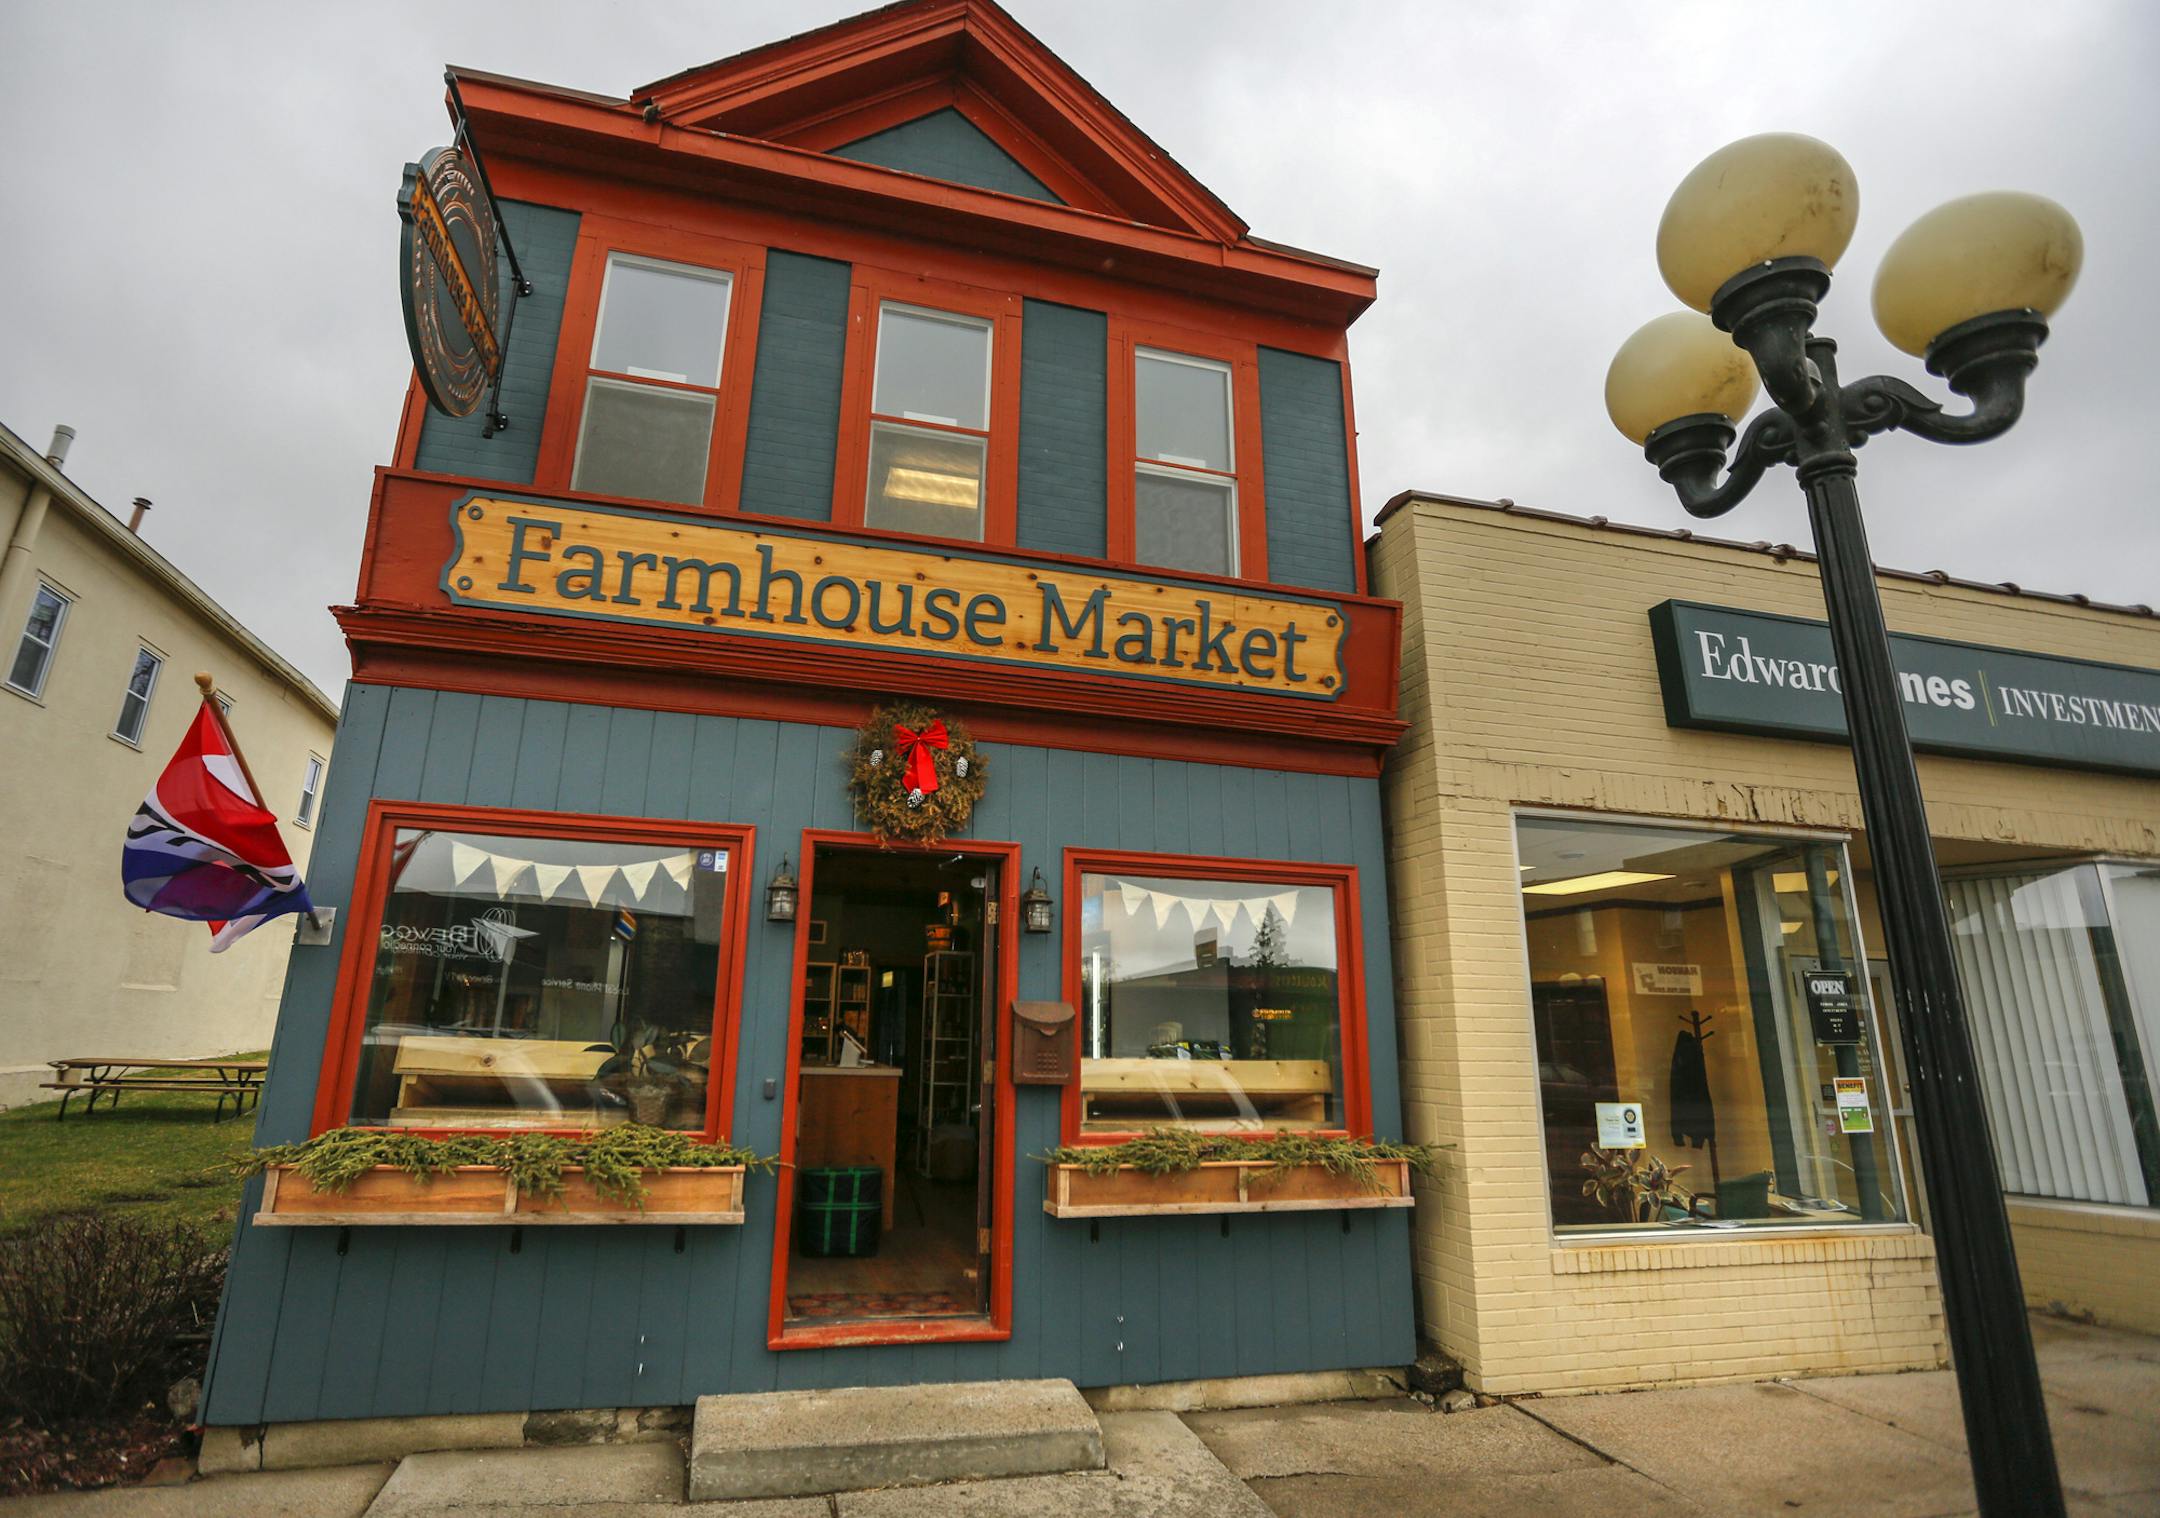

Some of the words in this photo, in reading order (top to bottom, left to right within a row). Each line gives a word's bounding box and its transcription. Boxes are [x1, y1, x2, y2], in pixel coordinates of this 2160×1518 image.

[497, 516, 1006, 646] Farmhouse
[1033, 582, 1307, 681] Market
[1897, 672, 1976, 711] nes
[1998, 686, 2160, 732] INVESTMEN
[1811, 980, 1846, 995] OPEN
